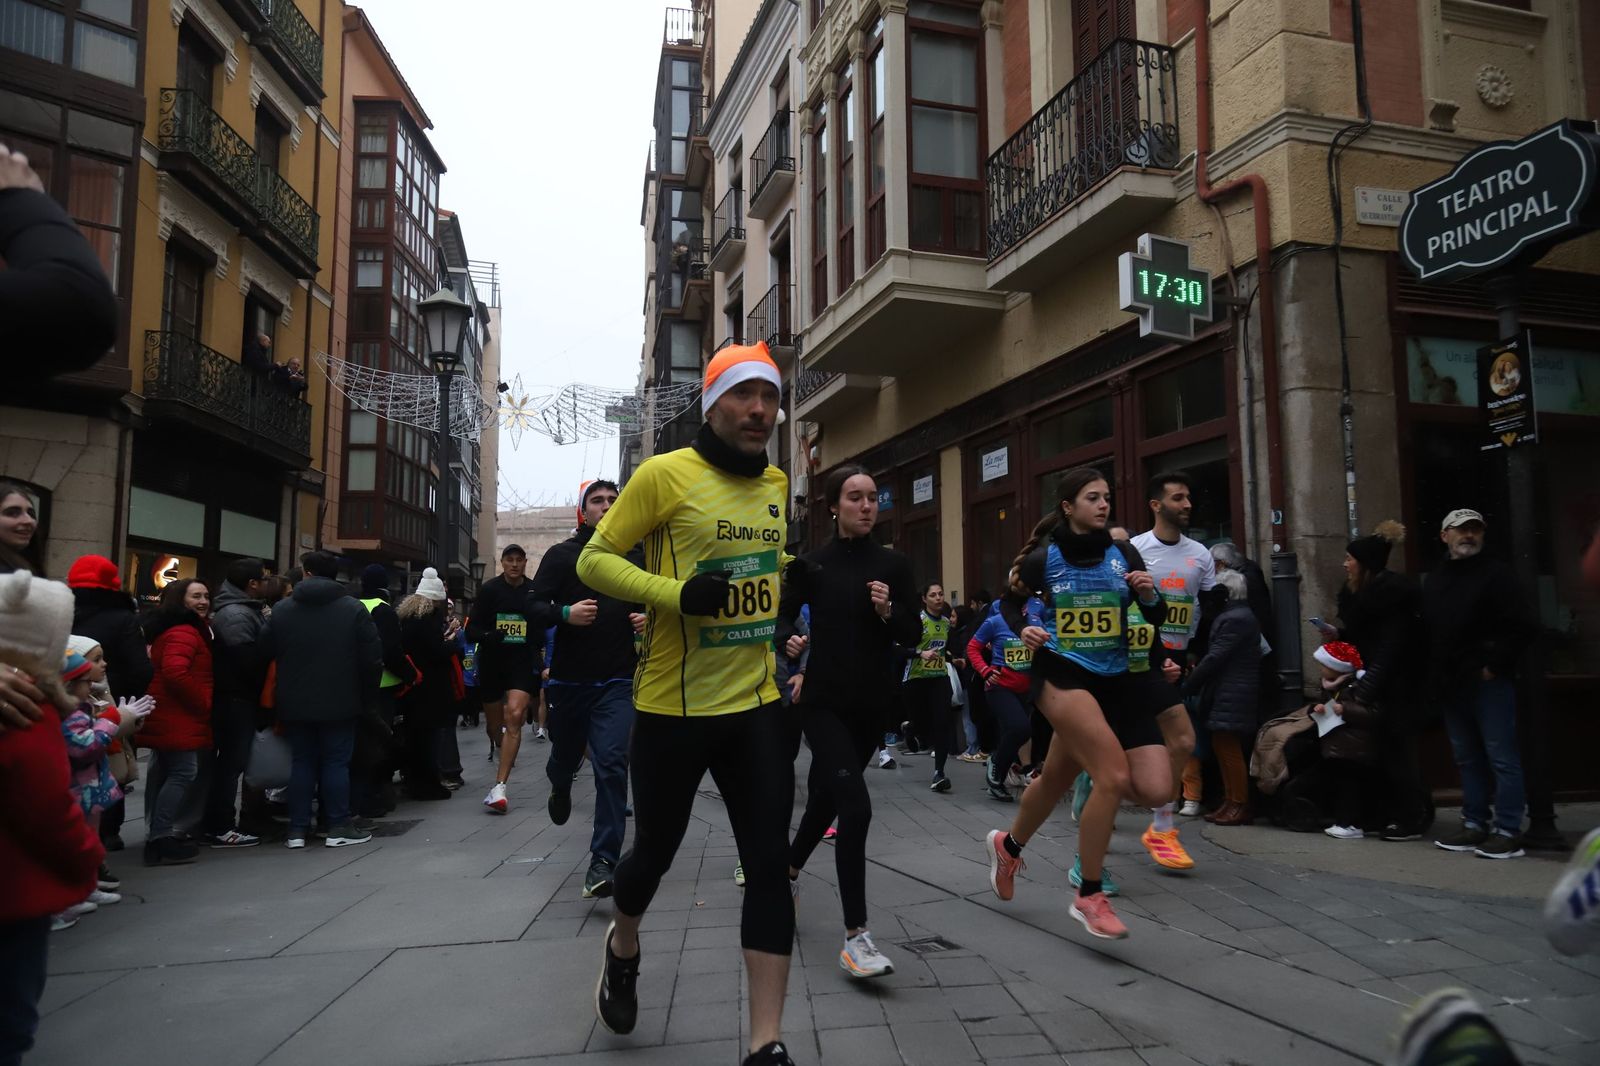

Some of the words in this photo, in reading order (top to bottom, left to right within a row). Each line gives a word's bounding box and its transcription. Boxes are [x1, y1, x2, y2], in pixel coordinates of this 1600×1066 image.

[1437, 160, 1534, 218] TEATRO
[1377, 194, 1402, 203] CALLE
[1382, 204, 1393, 212] DE
[1427, 190, 1558, 259] PRINCIPAL
[1138, 270, 1202, 305] 17:30
[1446, 350, 1462, 363] Un
[713, 578, 772, 619] 086
[1061, 610, 1112, 634] 295
[727, 630, 752, 640] CAJA
[1007, 649, 1030, 662] 520
